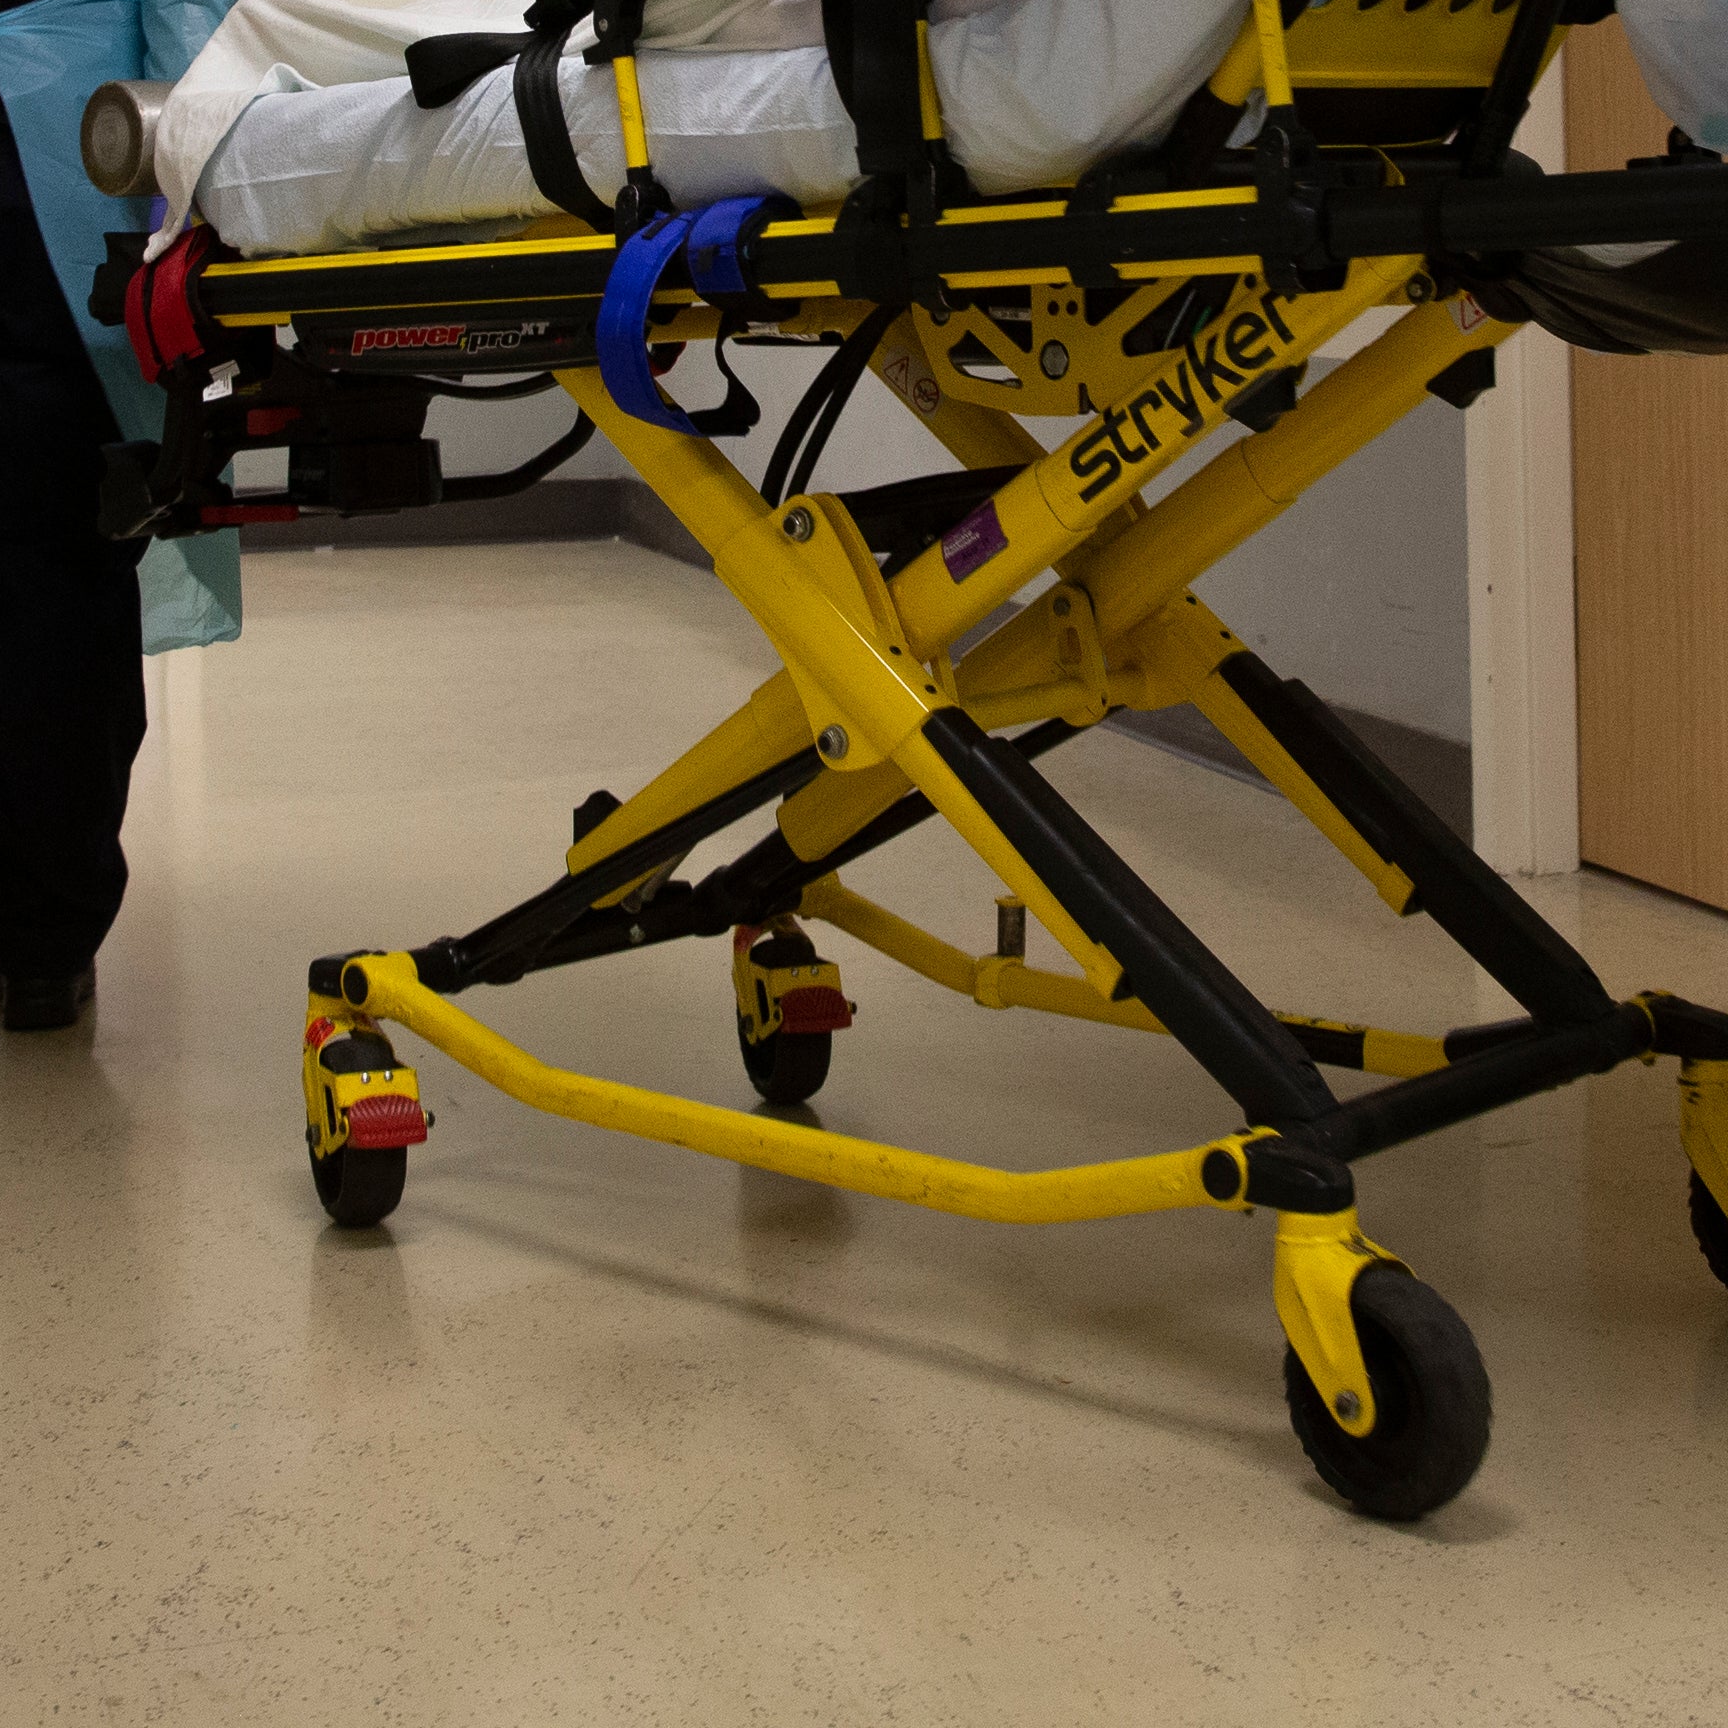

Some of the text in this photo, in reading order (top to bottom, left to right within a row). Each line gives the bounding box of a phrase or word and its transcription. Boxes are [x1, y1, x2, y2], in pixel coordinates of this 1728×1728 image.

[351, 322, 550, 356] power pro XT
[1070, 290, 1296, 504] stryker
